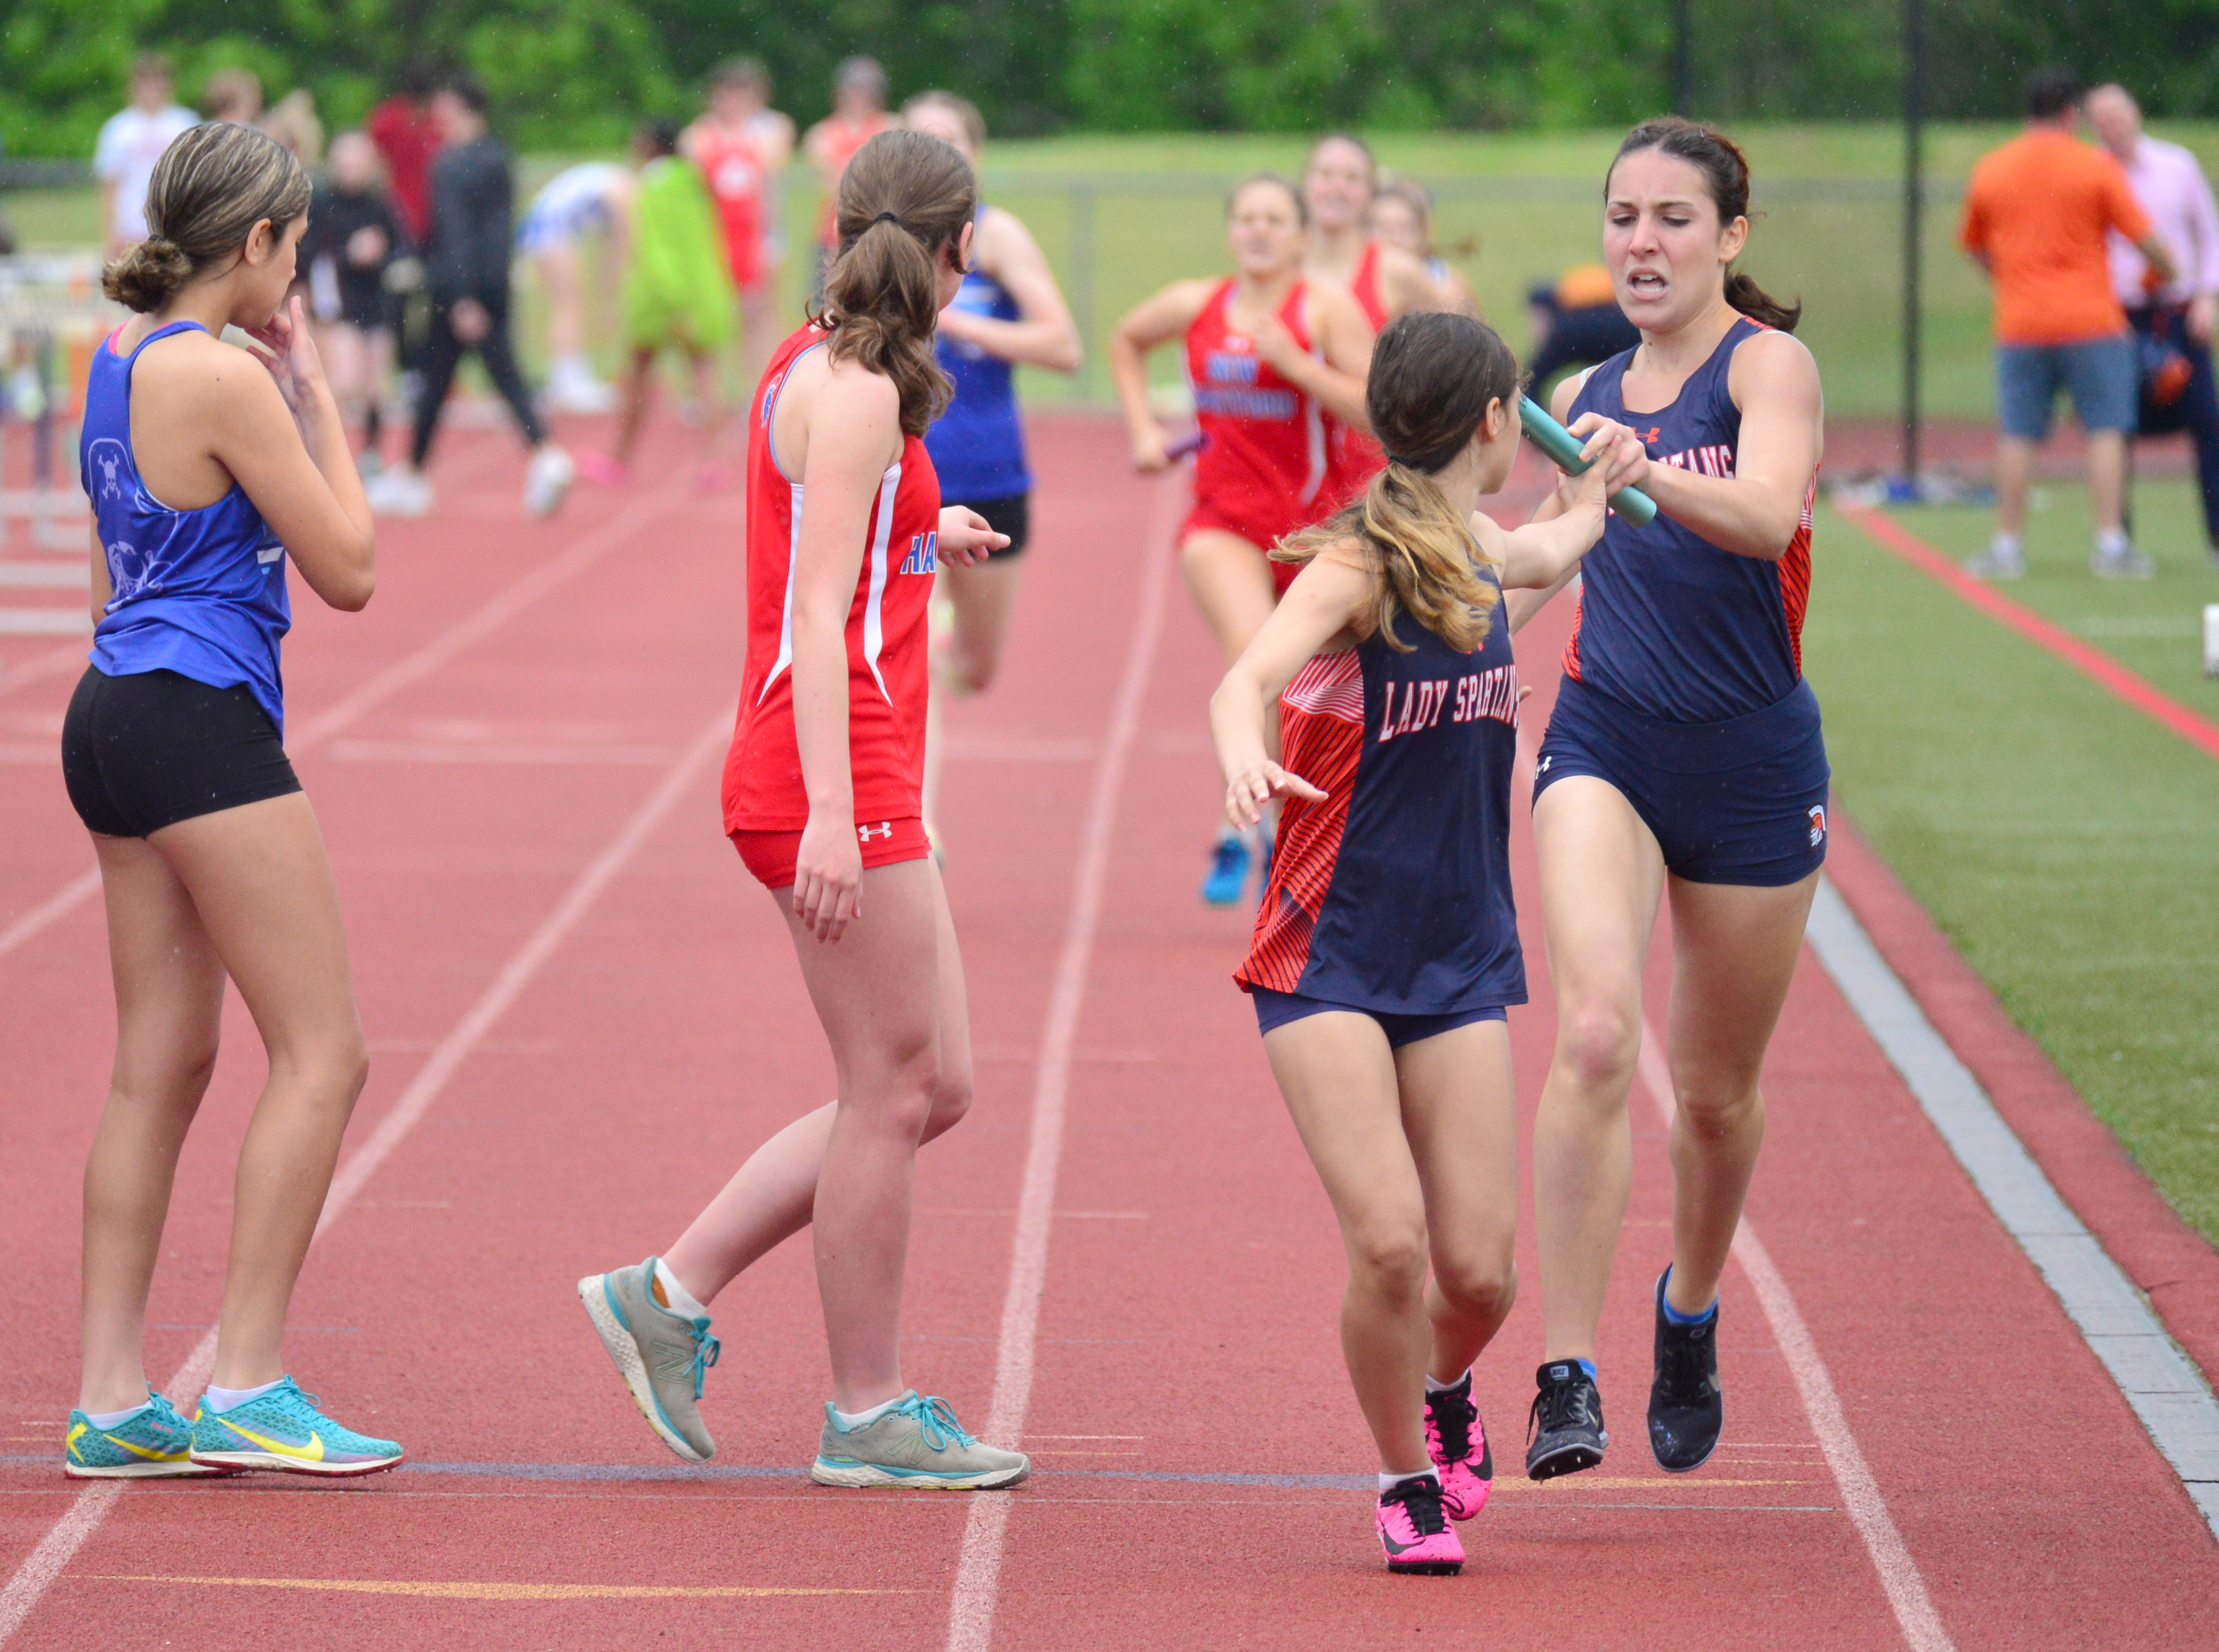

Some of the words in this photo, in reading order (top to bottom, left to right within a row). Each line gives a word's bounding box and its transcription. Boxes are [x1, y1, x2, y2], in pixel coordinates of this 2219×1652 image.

[899, 531, 938, 575] HA
[1378, 680, 1449, 742] LADY
[1453, 663, 1520, 729] SPARTANS
